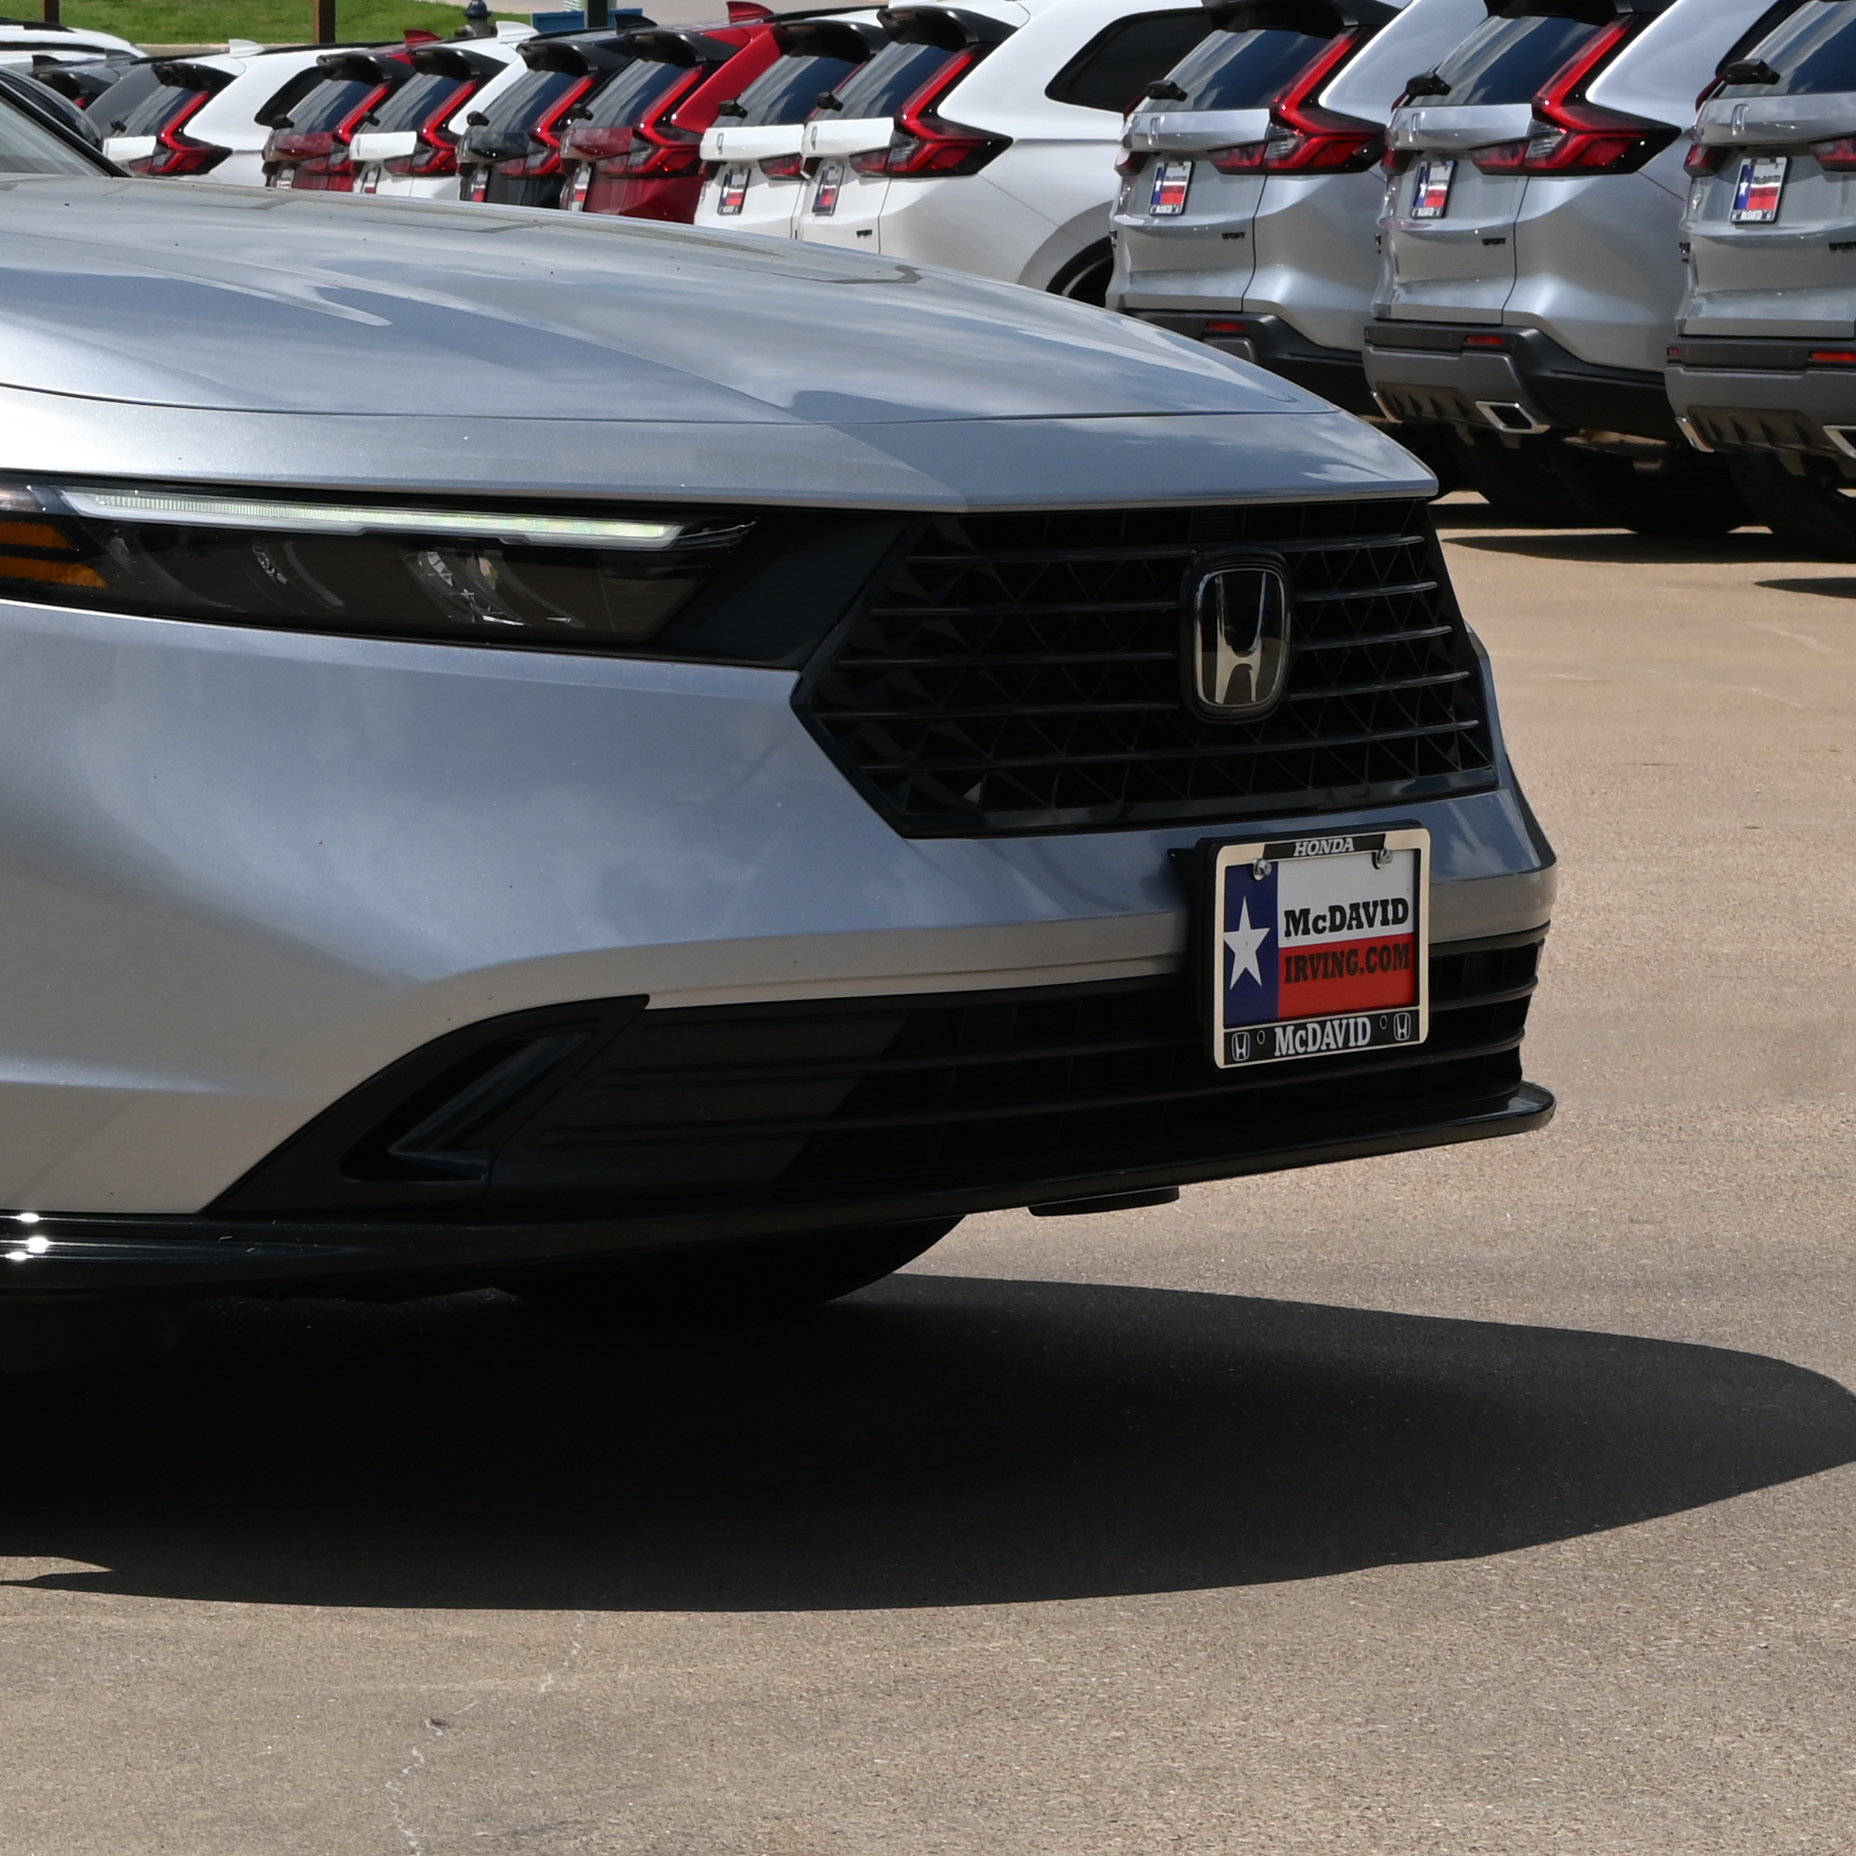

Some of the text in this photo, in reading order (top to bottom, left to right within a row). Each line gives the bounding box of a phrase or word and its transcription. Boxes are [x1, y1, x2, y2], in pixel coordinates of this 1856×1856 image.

[1293, 838, 1355, 857] HONDA
[1284, 897, 1409, 938] McDAVID
[1285, 943, 1410, 984] IRVING.COM
[1274, 1016, 1371, 1057] McDAVID
